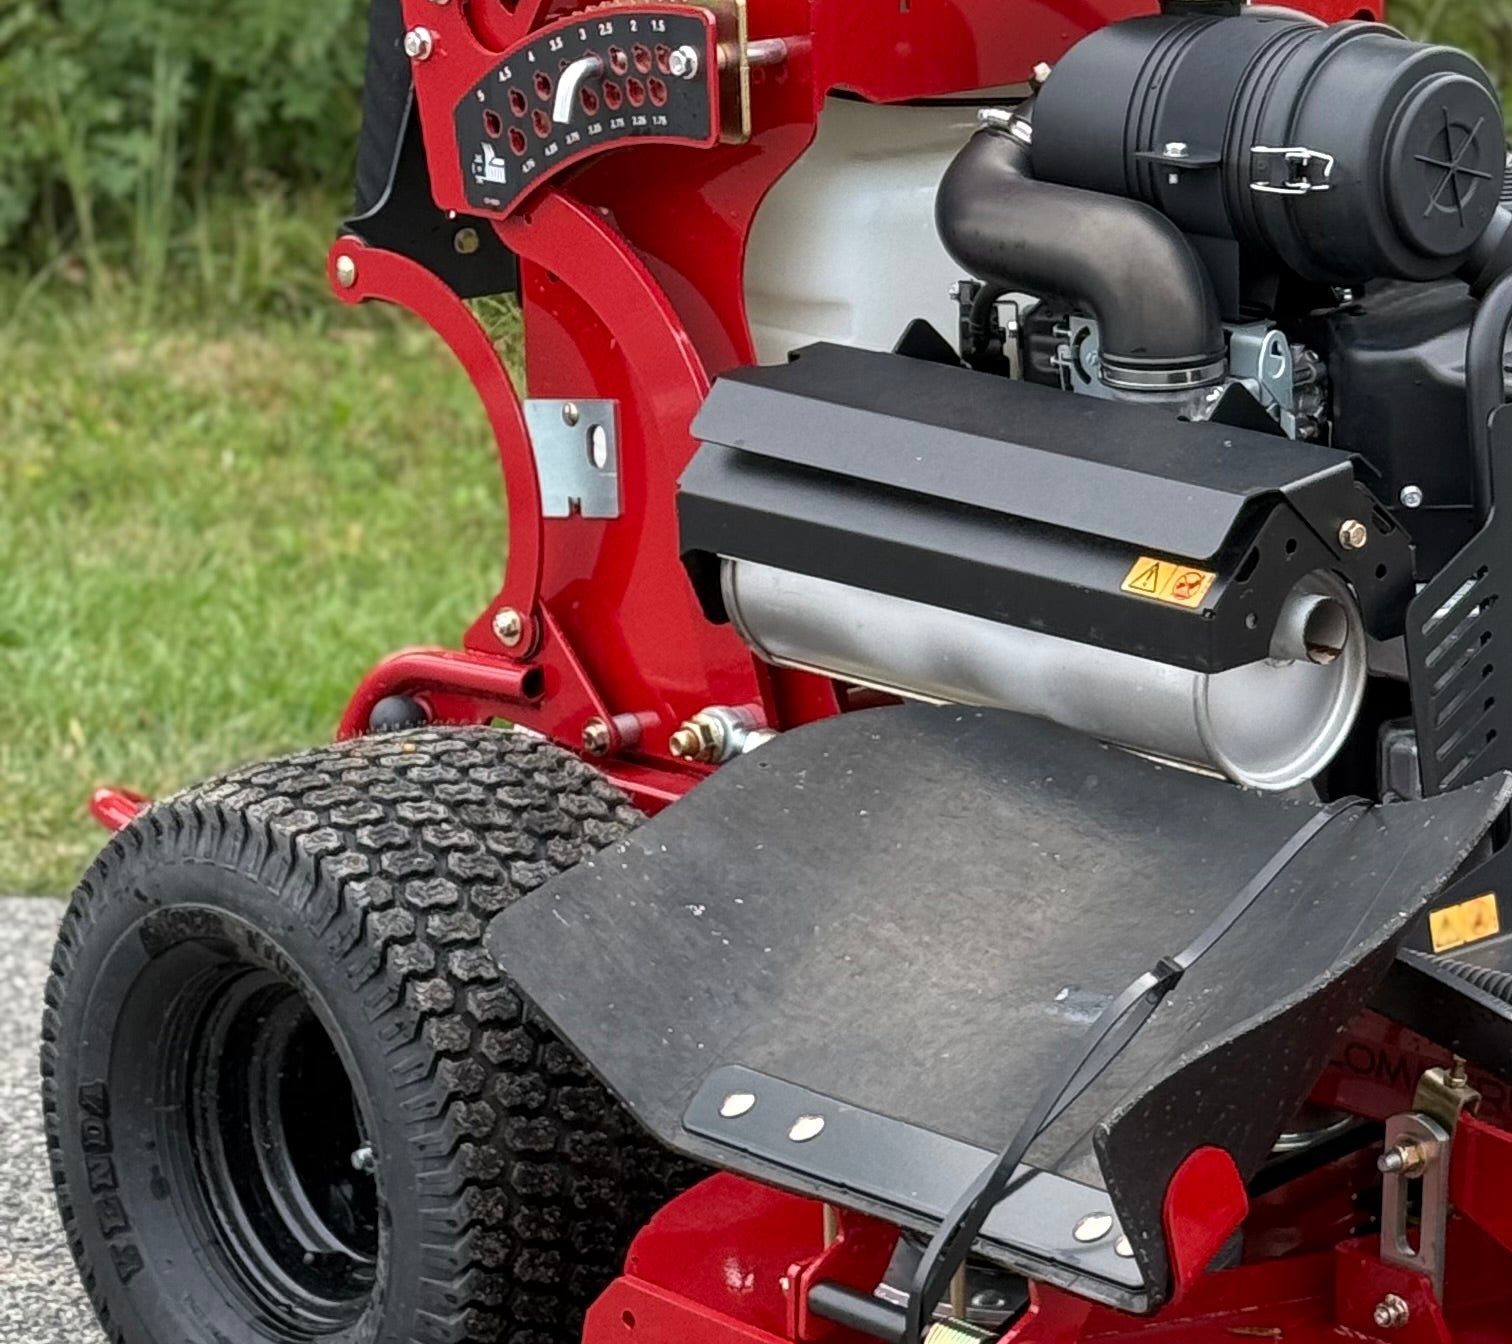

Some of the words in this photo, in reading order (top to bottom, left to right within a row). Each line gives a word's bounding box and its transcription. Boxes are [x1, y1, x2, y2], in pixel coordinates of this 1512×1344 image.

[476, 89, 486, 102] 5
[549, 36, 564, 51] 3.5
[578, 28, 587, 41] 3
[598, 22, 613, 36] 2.5
[629, 19, 638, 32] 2
[651, 19, 666, 32] 1.5
